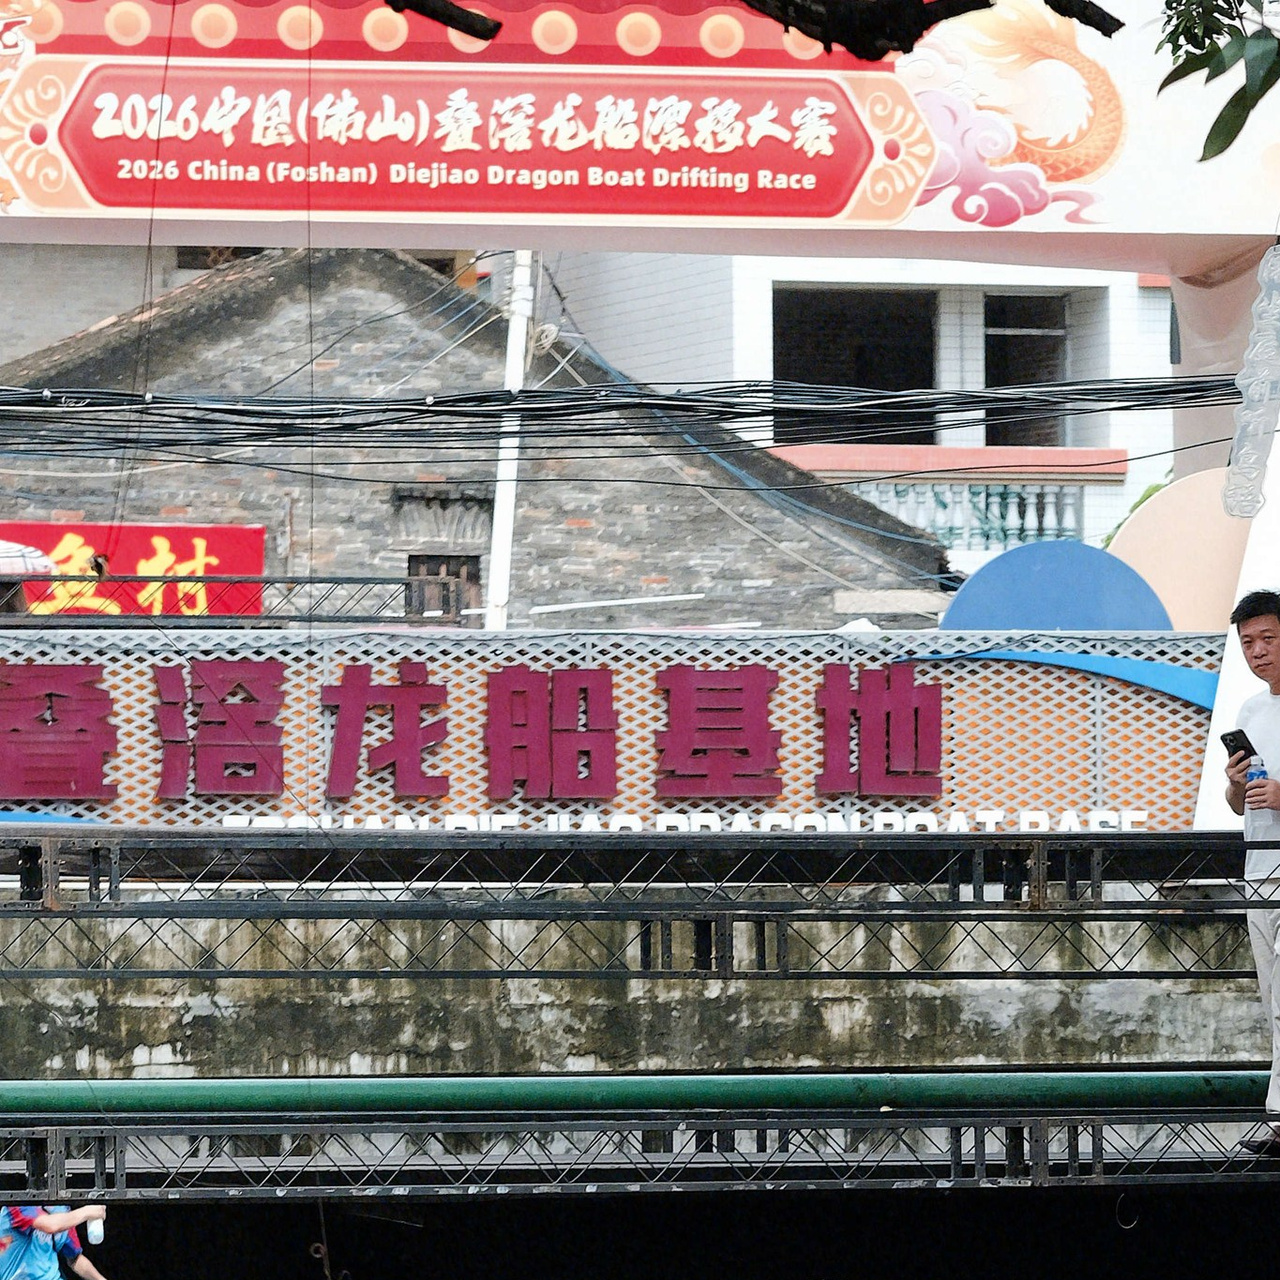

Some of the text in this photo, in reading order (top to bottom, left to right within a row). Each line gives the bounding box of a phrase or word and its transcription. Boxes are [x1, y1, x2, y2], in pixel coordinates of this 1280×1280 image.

[117, 158, 817, 193] 2026 China (Foshan) Diejiao Dragon Boat Drifting Race
